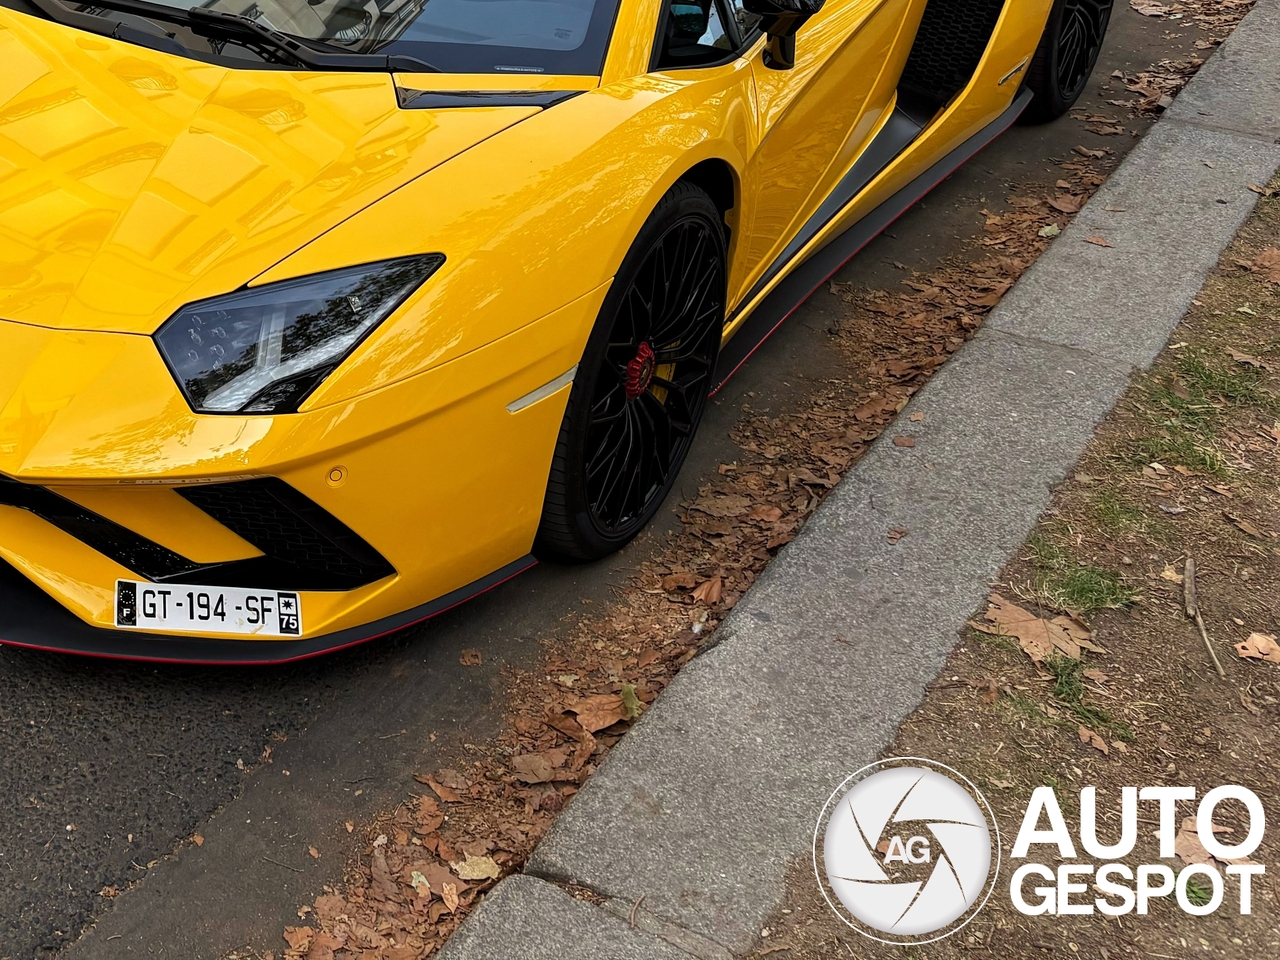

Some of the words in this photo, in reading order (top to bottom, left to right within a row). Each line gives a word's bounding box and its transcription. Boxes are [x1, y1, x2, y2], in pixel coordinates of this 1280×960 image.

[122, 608, 131, 617] F
[142, 590, 274, 624] GT-194-SF
[280, 615, 298, 629] 75
